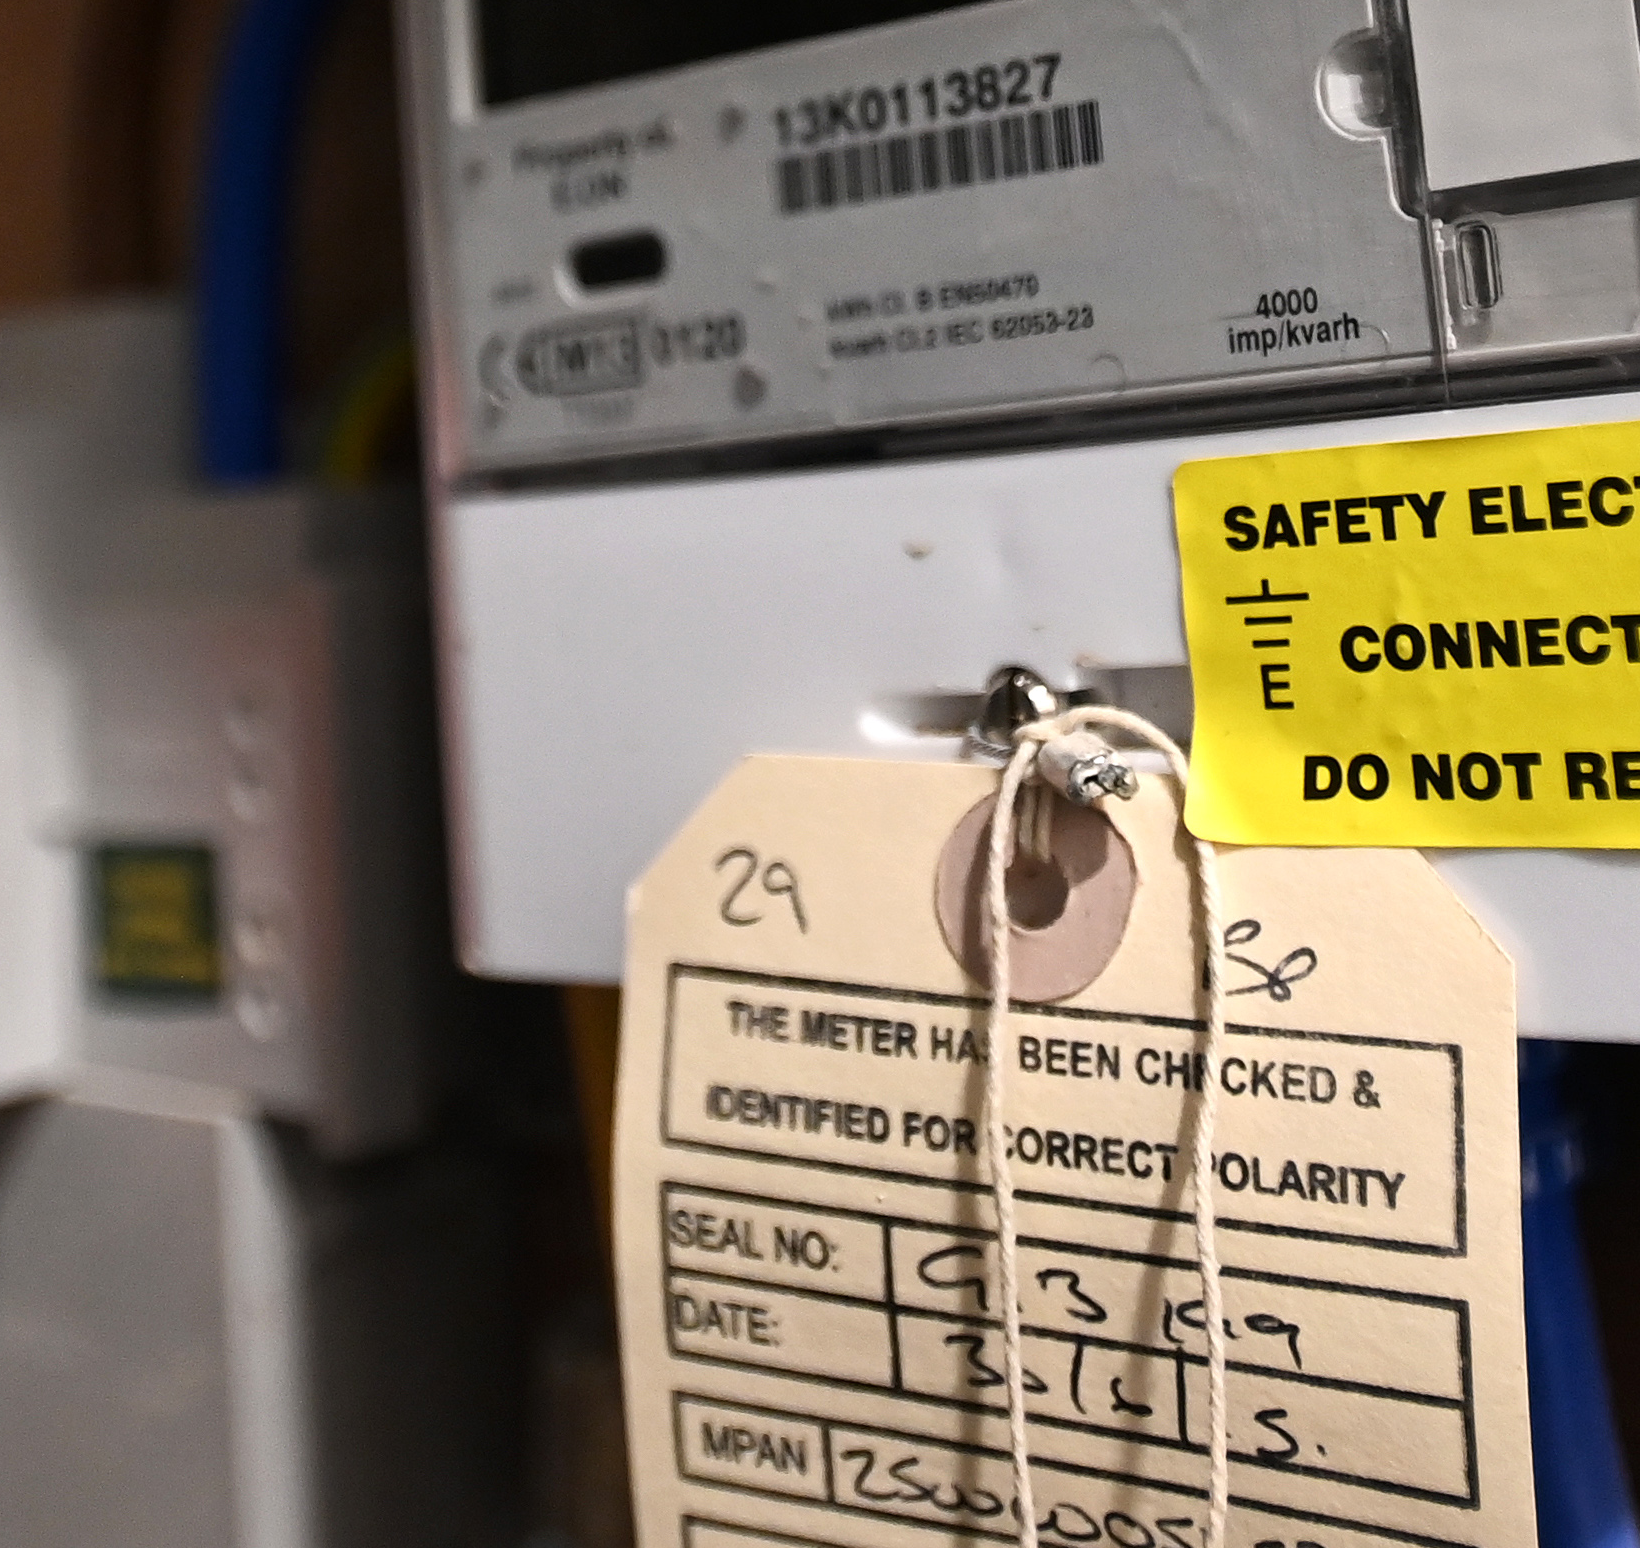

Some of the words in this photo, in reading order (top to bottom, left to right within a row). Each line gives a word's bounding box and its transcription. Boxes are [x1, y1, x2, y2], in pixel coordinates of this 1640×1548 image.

[1256, 287, 1317, 318] 4000
[1227, 311, 1360, 356] imp/kvarh
[1223, 490, 1447, 551] SAFETY
[1302, 752, 1390, 801] DO
[1411, 751, 1542, 801] NOT
[715, 848, 807, 935] 29
[726, 1000, 790, 1043] THE
[799, 1009, 918, 1061] METER
[1019, 1035, 1121, 1081] BEEN
[1353, 1069, 1382, 1109] &
[902, 1110, 978, 1157] FOR
[1210, 1151, 1407, 1211] OLARITY
[667, 1208, 764, 1260] SEAL
[773, 1225, 841, 1274] NO:
[671, 1291, 782, 1348] DATE:
[700, 1420, 809, 1477] MPAN
